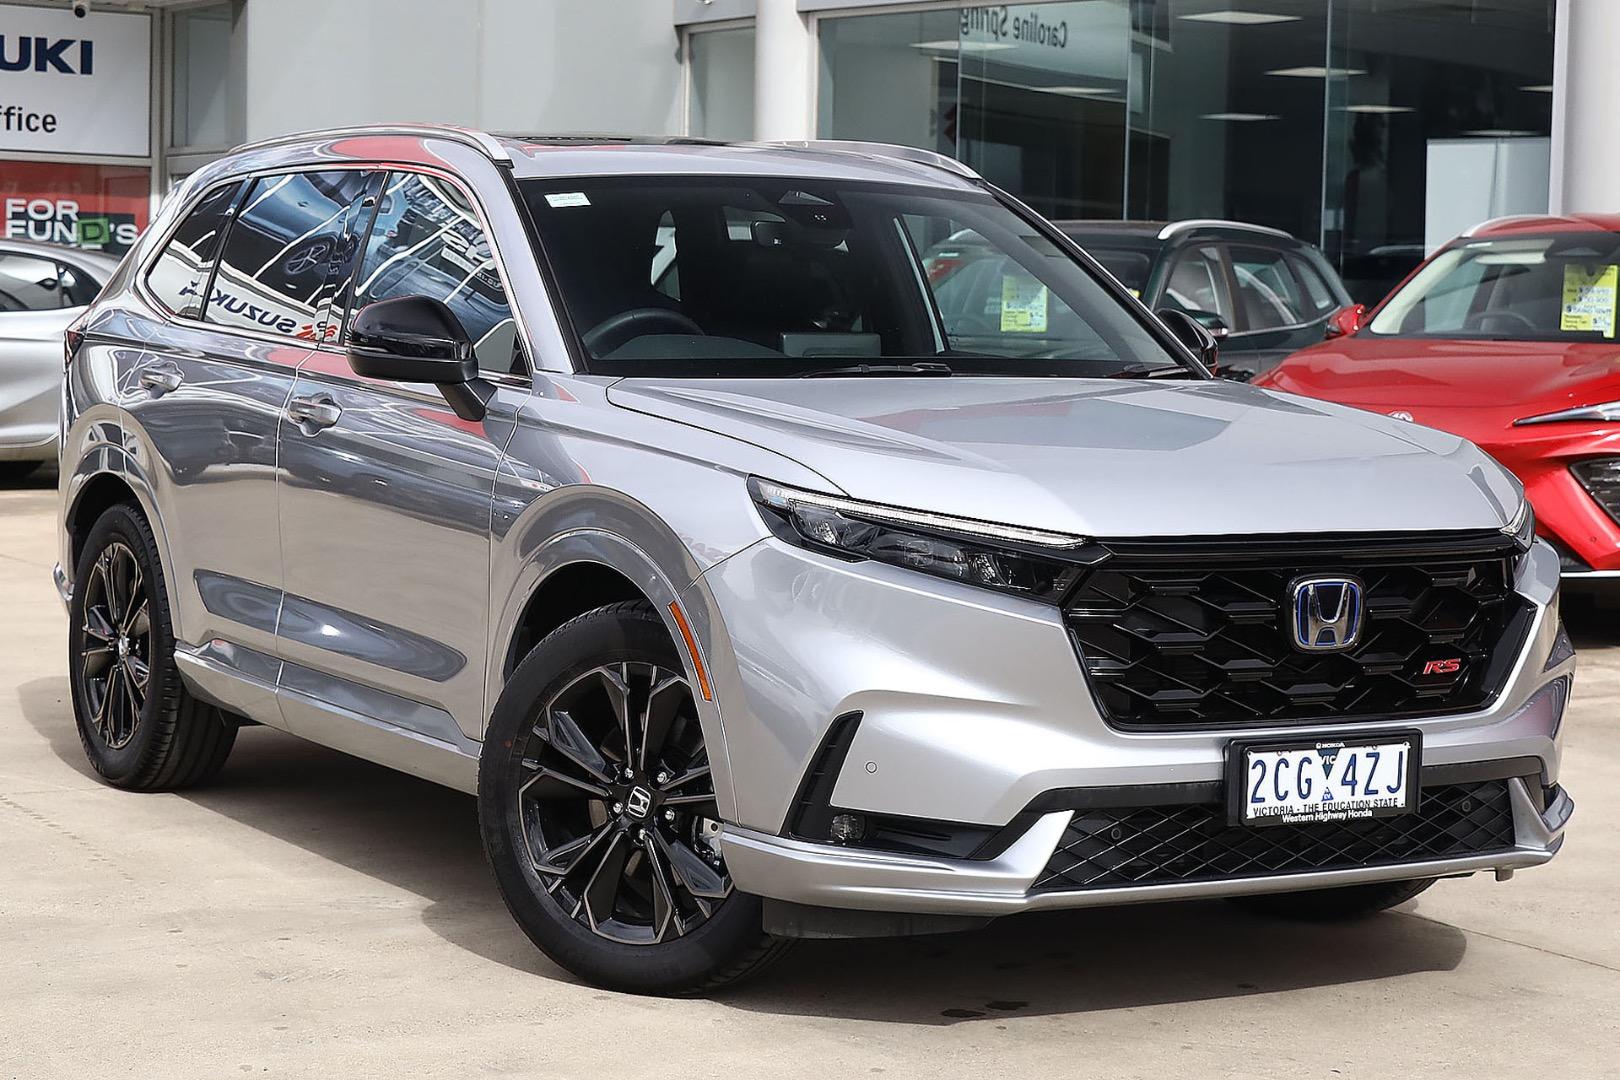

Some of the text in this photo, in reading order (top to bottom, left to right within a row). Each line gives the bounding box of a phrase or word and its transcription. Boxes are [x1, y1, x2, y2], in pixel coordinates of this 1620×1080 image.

[0, 34, 93, 75] UKI
[5, 198, 79, 221] FOR
[5, 219, 139, 246] FUND'S
[1422, 657, 1461, 675] RS
[1250, 750, 1404, 804] 2CG 4ZJ
[1252, 804, 1294, 817] VICTORIA
[1303, 802, 1320, 814] THE
[1321, 798, 1371, 812] EDUCATION
[1373, 796, 1399, 809] STATE
[1282, 807, 1373, 823] Western Highway Honda
